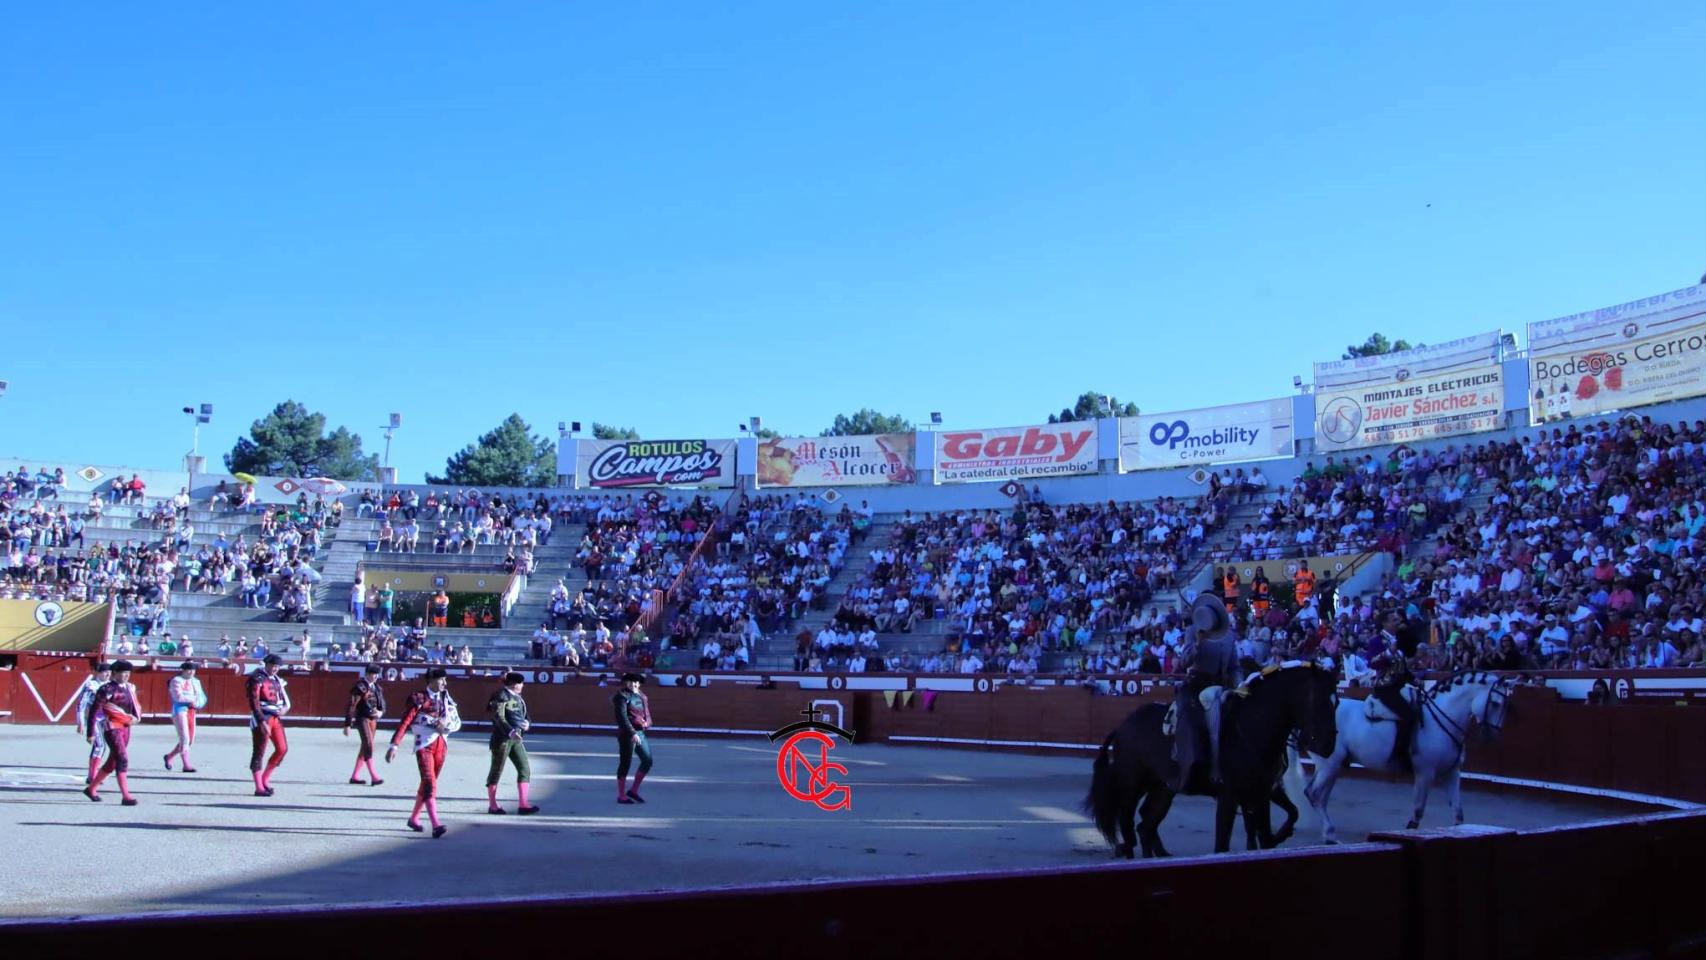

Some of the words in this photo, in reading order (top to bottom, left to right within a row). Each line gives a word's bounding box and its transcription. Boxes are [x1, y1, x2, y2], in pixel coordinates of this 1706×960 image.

[1536, 351, 1628, 380] Bodegas
[1634, 335, 1706, 361] Cerro
[1363, 386, 1423, 403] MONTAJES
[1365, 402, 1409, 422] Javier
[1412, 391, 1478, 416] Sánchez
[791, 441, 861, 465] Mesón
[943, 428, 1093, 462] Gaby
[1180, 448, 1226, 459] C-Power
[592, 446, 718, 482] Campos
[821, 458, 900, 480] Alcocer
[960, 467, 1008, 479] catedral
[1010, 466, 1029, 476] del
[671, 472, 704, 482] .com
